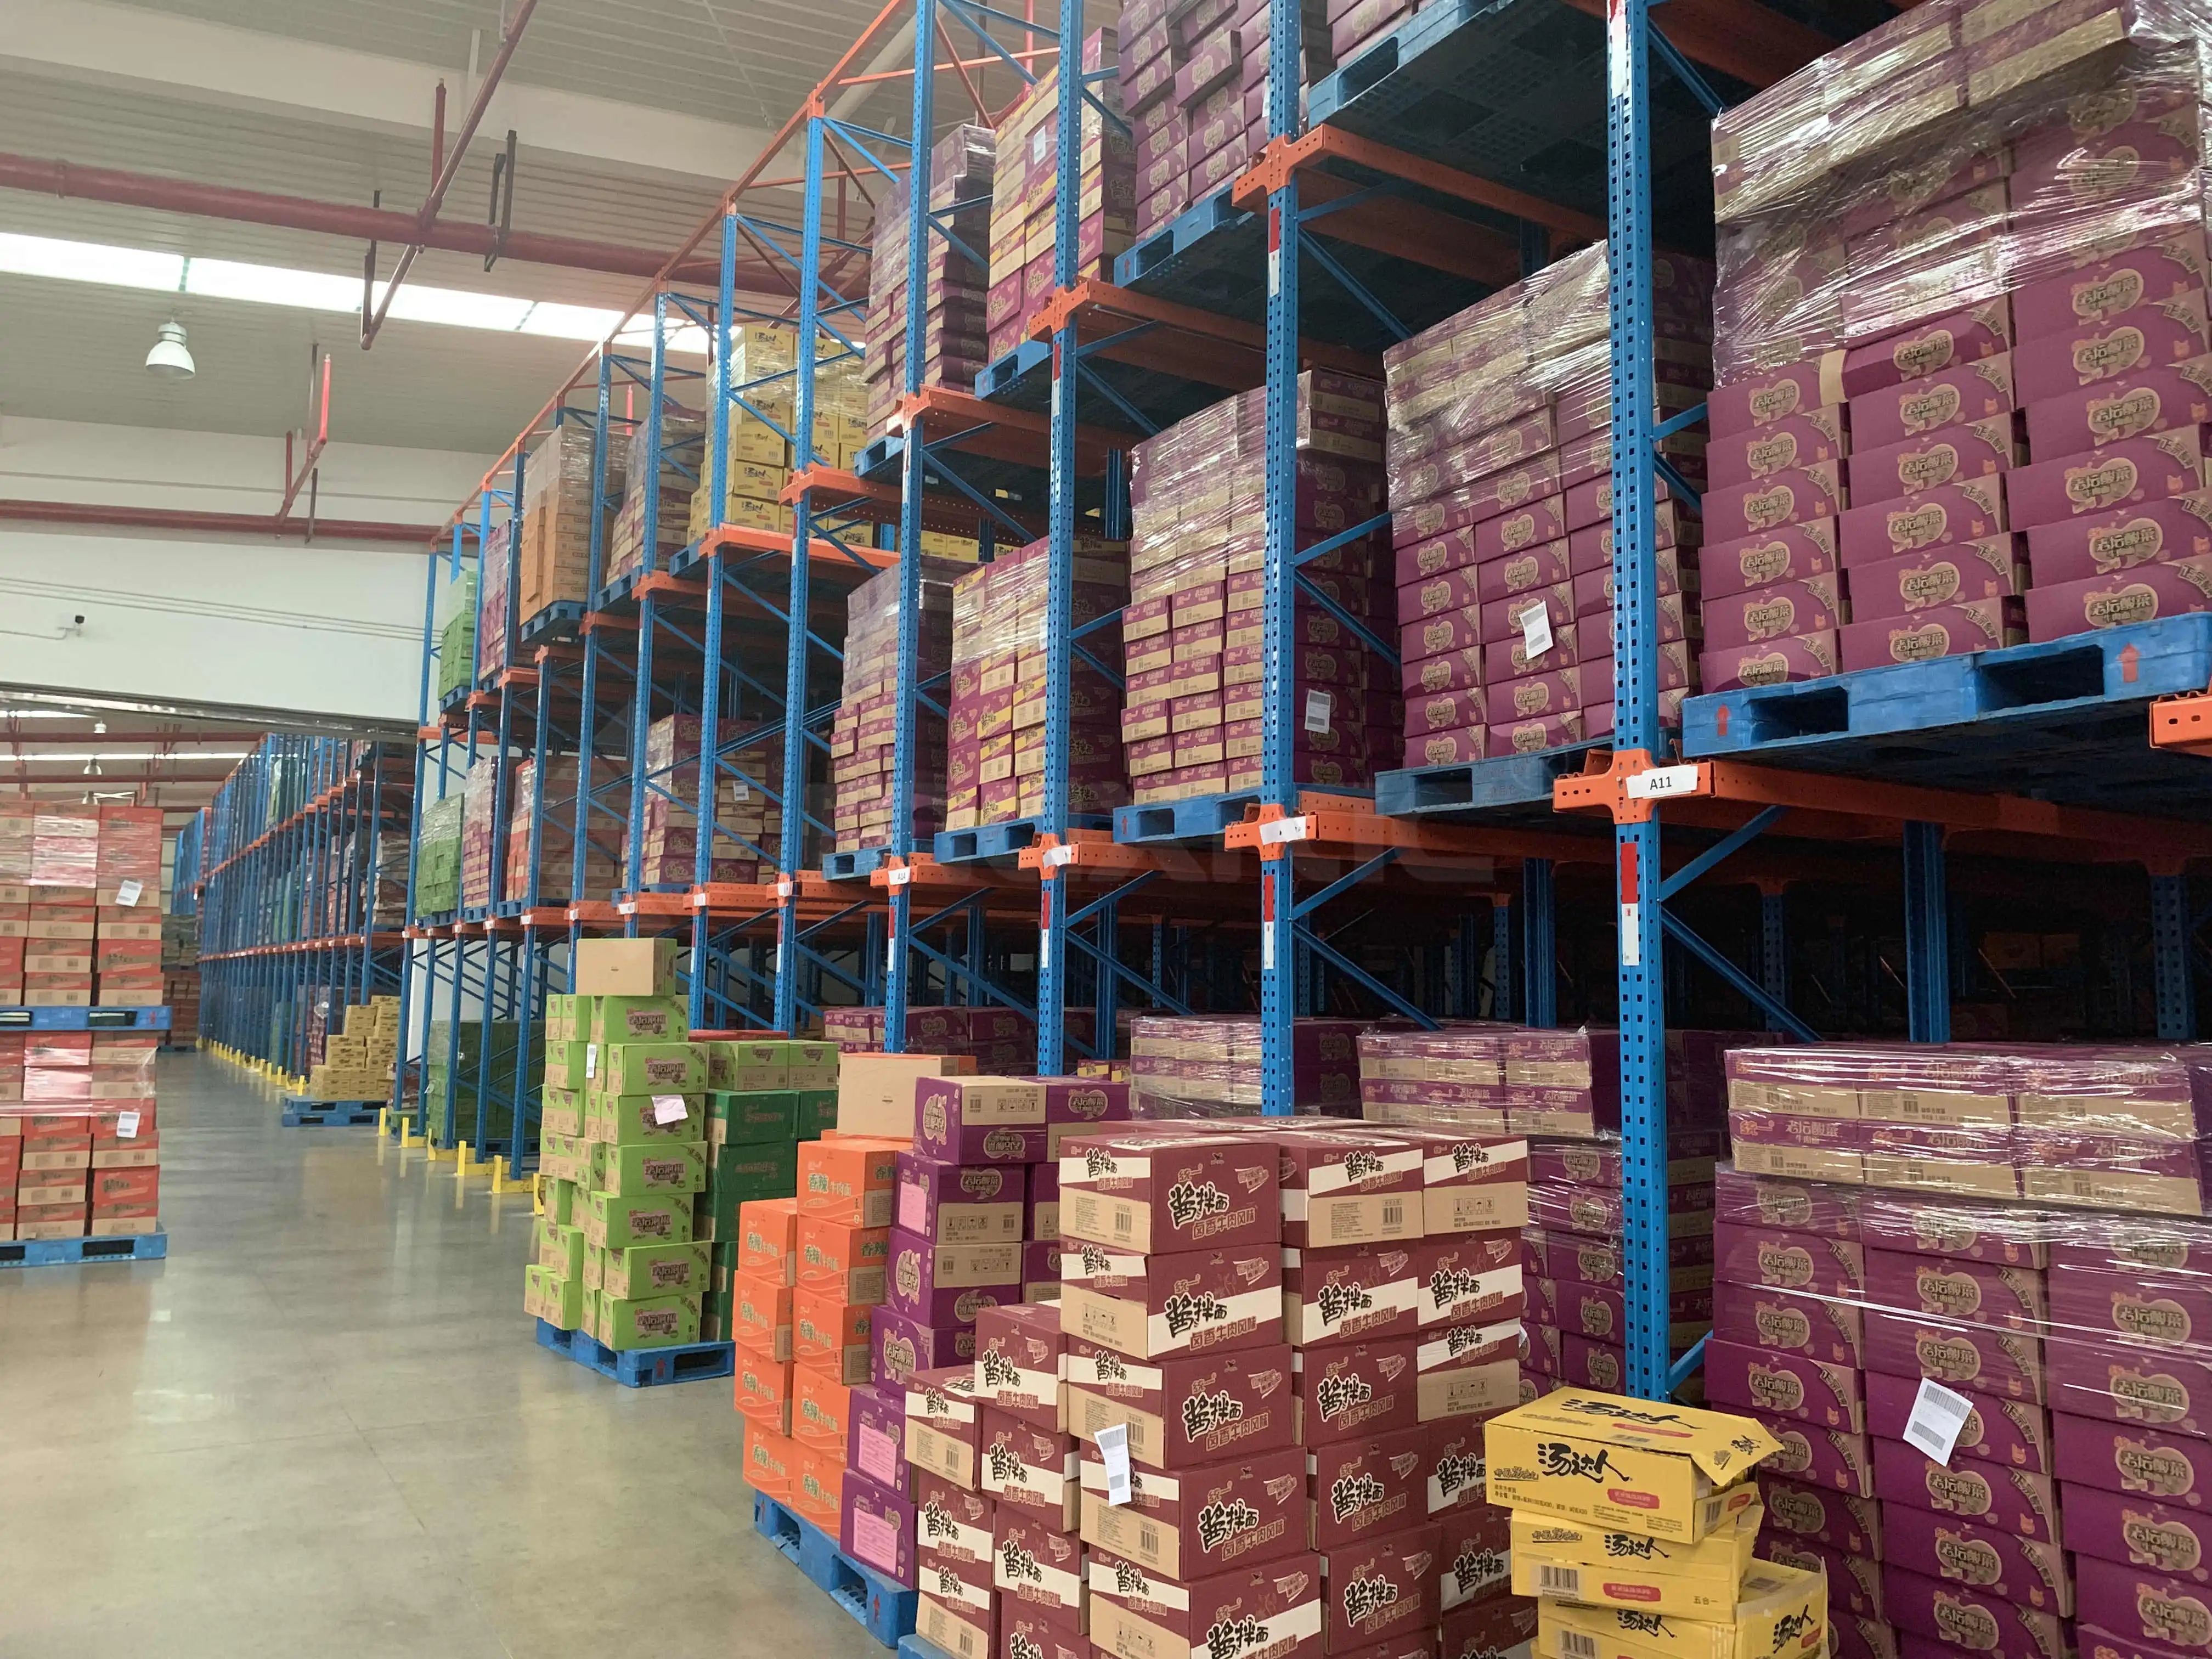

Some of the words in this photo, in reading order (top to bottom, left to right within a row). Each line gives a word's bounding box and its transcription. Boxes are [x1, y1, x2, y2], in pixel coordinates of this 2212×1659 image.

[1650, 776, 1672, 790] A11
[1086, 1148, 1118, 1178] 酱拌面
[1178, 1164, 1203, 1182] 统一
[1345, 1150, 1384, 1182] 酱拌面
[1452, 1143, 1488, 1173] 酱拌面
[1169, 1181, 1229, 1230] 酱拌面
[1193, 1207, 1255, 1239] 卤香牛肉风味
[1081, 1244, 1111, 1275] 酱拌面
[1327, 1265, 1350, 1284] 统一
[1174, 1273, 1201, 1294] 统一
[1431, 1267, 1480, 1310] 酱拌面
[1165, 1291, 1228, 1339] 酱拌面
[1318, 1282, 1372, 1326] 酱拌面
[1451, 1291, 1504, 1320] 卤香牛肉风味
[1189, 1316, 1257, 1351] 卤香牛肉风味
[1339, 1305, 1398, 1338] 卤香牛肉风味
[1447, 1325, 1482, 1357] 酱拌面
[983, 1350, 1021, 1387] 酱拌面
[1095, 1350, 1127, 1381] 酱拌面
[1326, 1357, 1348, 1376] 统一
[1192, 1372, 1217, 1393] 统一
[1317, 1373, 1372, 1422] 酱拌面
[926, 1387, 949, 1415] 酱拌面
[996, 1390, 1039, 1409] 卤香牛肉风味
[1338, 1394, 1394, 1431] 卤香牛肉风味
[1183, 1390, 1243, 1443] 酱拌面
[1206, 1413, 1269, 1452] 卤香牛肉风味
[990, 1443, 1028, 1483] 酱拌面
[1340, 1457, 1362, 1477] 统一
[1437, 1452, 1486, 1497] 酱拌面
[1538, 1443, 1630, 1483] 汤达人
[1003, 1484, 1045, 1507] 卤香牛肉风味
[1208, 1481, 1233, 1503] 统一
[1331, 1472, 1385, 1522] 酱拌面
[925, 1500, 959, 1540] 酱拌面
[1198, 1498, 1260, 1553] 酱拌面
[1352, 1491, 1407, 1531] 卤香牛肉风味
[1222, 1518, 1284, 1561] 卤香牛肉风味
[1604, 1534, 1671, 1560] 汤达人
[1002, 1540, 1042, 1584] 酱拌面
[1116, 1560, 1149, 1596] 酱拌面
[1454, 1548, 1504, 1595] 酱拌面
[939, 1566, 963, 1596] 酱拌面
[1017, 1582, 1062, 1608] 卤香牛肉风味
[1216, 1596, 1242, 1621] 统一
[1344, 1574, 1398, 1628] 酱拌面
[1365, 1593, 1420, 1635] 卤香牛肉风味
[1206, 1614, 1268, 1659] 酱拌面
[1617, 1609, 1678, 1637] 汤达人
